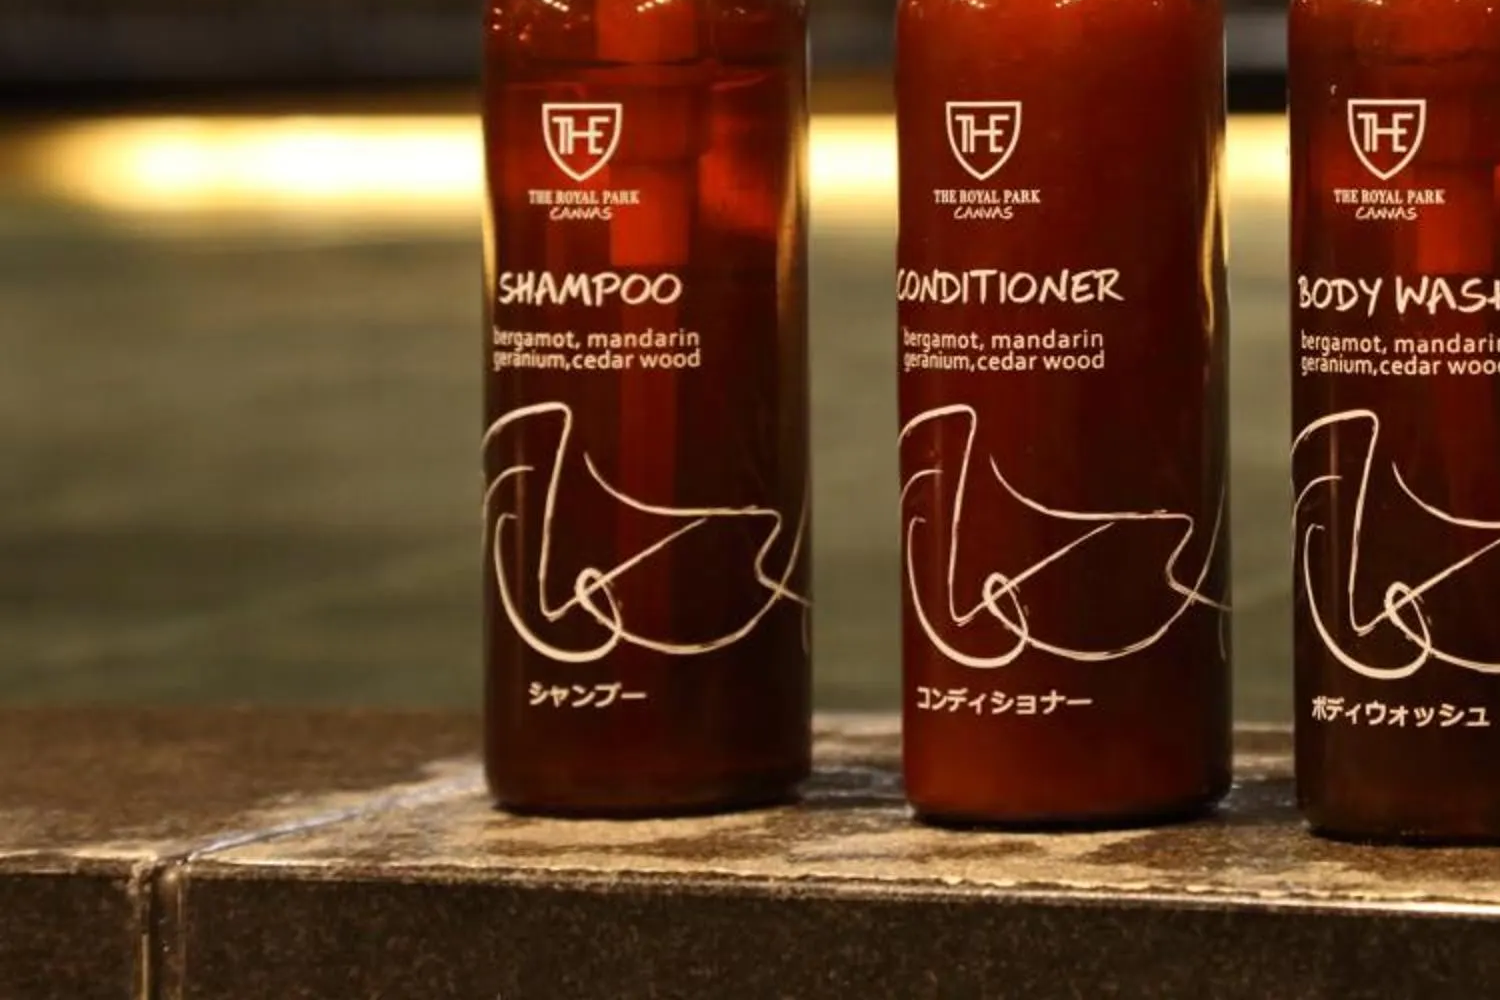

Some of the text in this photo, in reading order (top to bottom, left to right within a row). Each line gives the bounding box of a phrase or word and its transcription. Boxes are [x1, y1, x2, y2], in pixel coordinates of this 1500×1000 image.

[552, 116, 612, 154] THE
[955, 114, 1010, 153] THE
[1357, 113, 1414, 153] THE
[528, 190, 640, 205] THE ROYAL PARK
[933, 189, 1041, 204] THE ROYAL PARK
[1333, 189, 1446, 204] THE ROYAL PARK
[549, 206, 613, 221] CANVAS
[953, 205, 1014, 220] CANVAS
[1355, 205, 1418, 220] CANVAS
[499, 271, 683, 307] SHAMPOO
[896, 268, 1125, 305] CONDITIONER
[1297, 275, 1383, 317] BODY
[492, 326, 700, 351] bergamot, mandarin
[903, 326, 1104, 352] bergamot, mandarin
[1301, 329, 1387, 356] bergamot,
[639, 349, 701, 368] wood
[1043, 349, 1106, 369] wood
[528, 681, 648, 708] シャンプー
[917, 687, 1093, 715] コンディショナー
[1311, 696, 1491, 727] ボディウォッシュ
